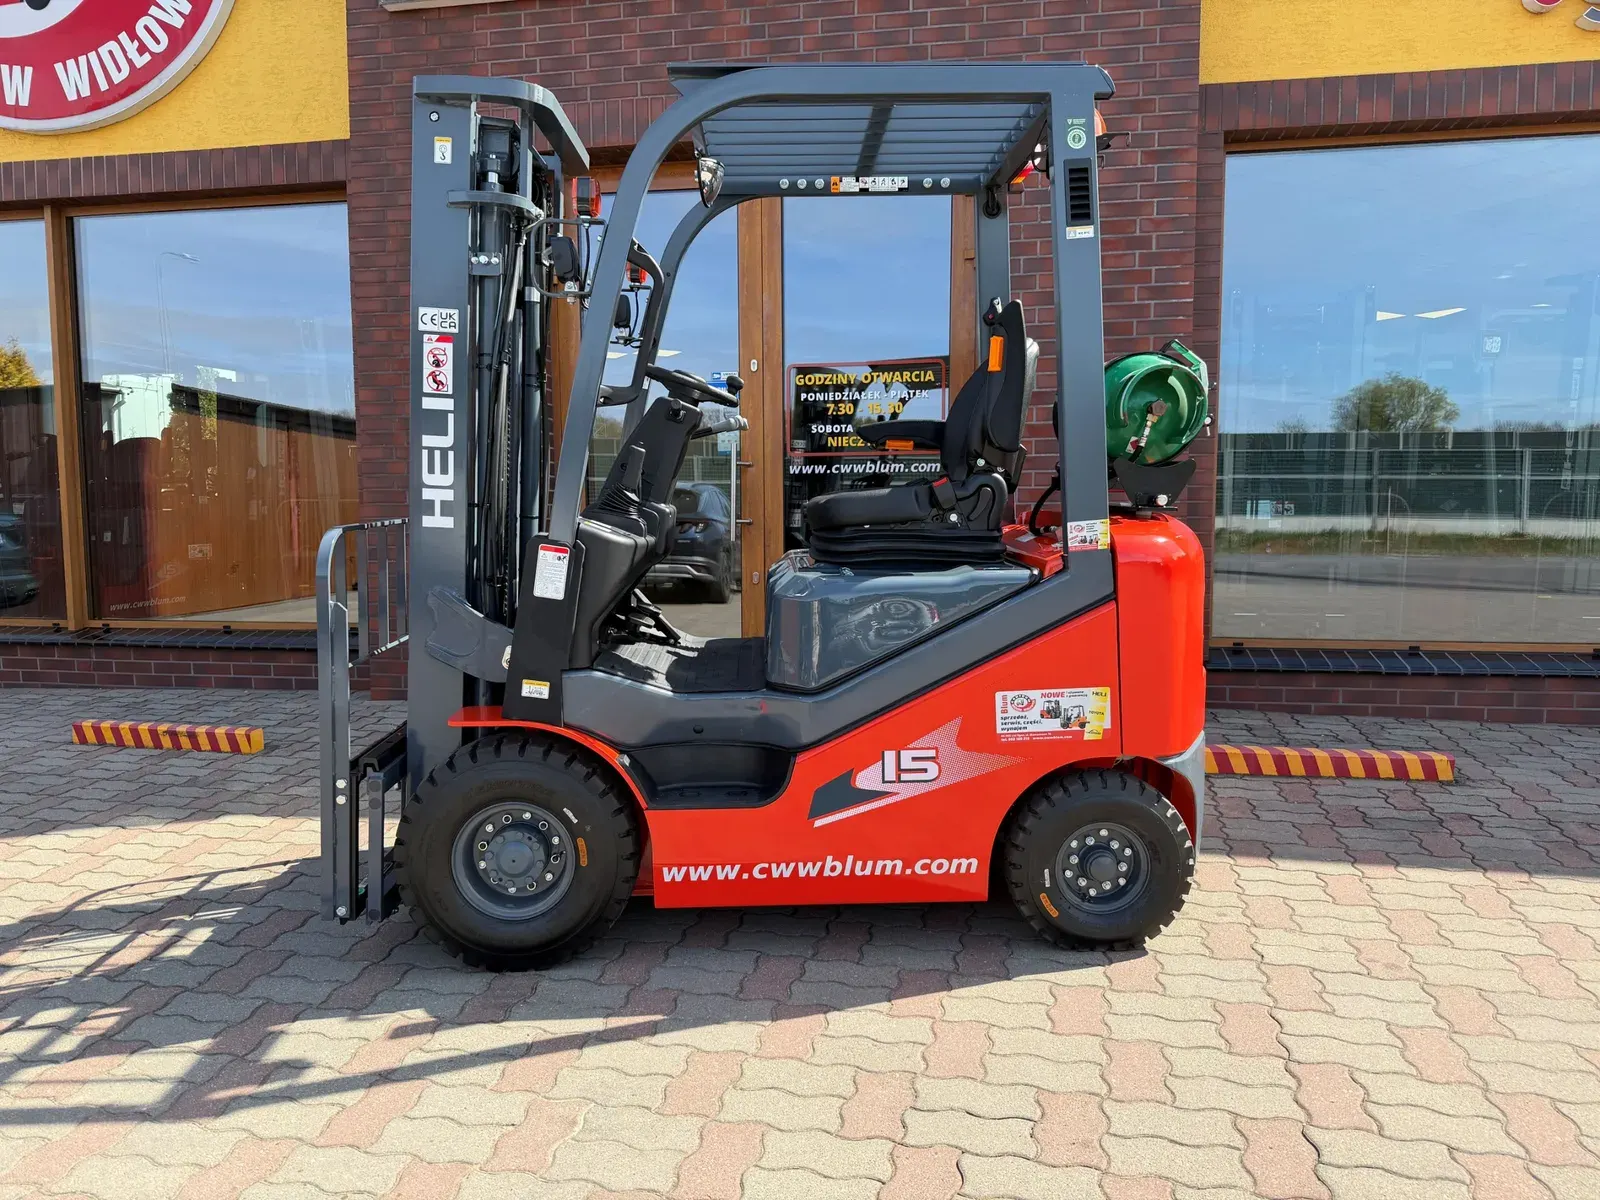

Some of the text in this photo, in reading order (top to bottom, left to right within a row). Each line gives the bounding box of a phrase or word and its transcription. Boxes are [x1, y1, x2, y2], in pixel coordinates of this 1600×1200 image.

[795, 370, 935, 386] GODZINY OTWARCIA
[800, 390, 881, 401] PONIEDZIAŁEK
[890, 389, 929, 400] PIĄTEK
[826, 403, 854, 415] 7.30
[811, 424, 854, 434] SOBOTA
[827, 436, 870, 447] NIECZ
[422, 397, 454, 528] HELI
[789, 461, 941, 474] www.cwwblum.com
[109, 595, 187, 612] www.cwwblum.com
[1040, 691, 1066, 699] NOWE
[882, 749, 940, 784] 15
[662, 854, 978, 882] www.cwwblum.com
